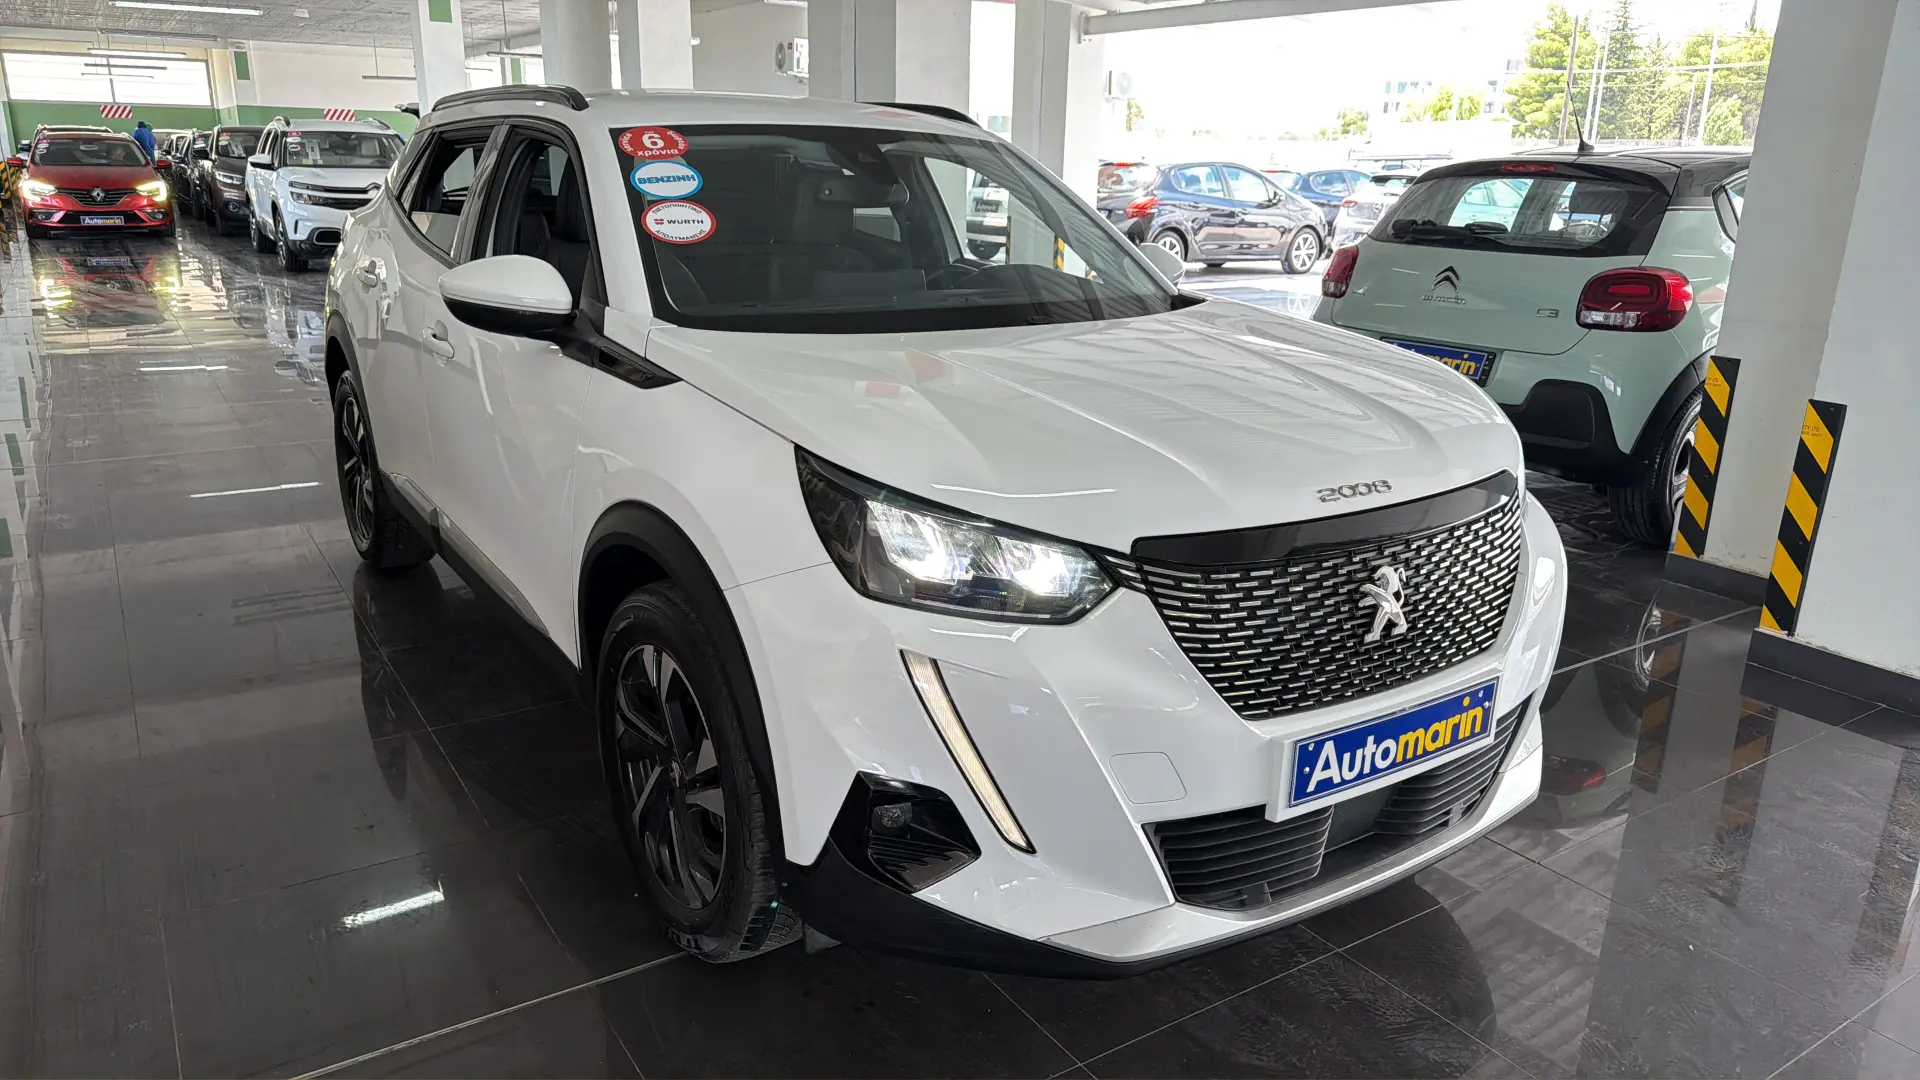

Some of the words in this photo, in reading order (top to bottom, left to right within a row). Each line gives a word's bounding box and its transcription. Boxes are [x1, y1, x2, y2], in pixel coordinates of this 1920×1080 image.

[642, 133, 665, 149] 6
[637, 148, 679, 157] χρόνια
[1316, 479, 1393, 503] 2008
[1306, 696, 1484, 793] Automarin
